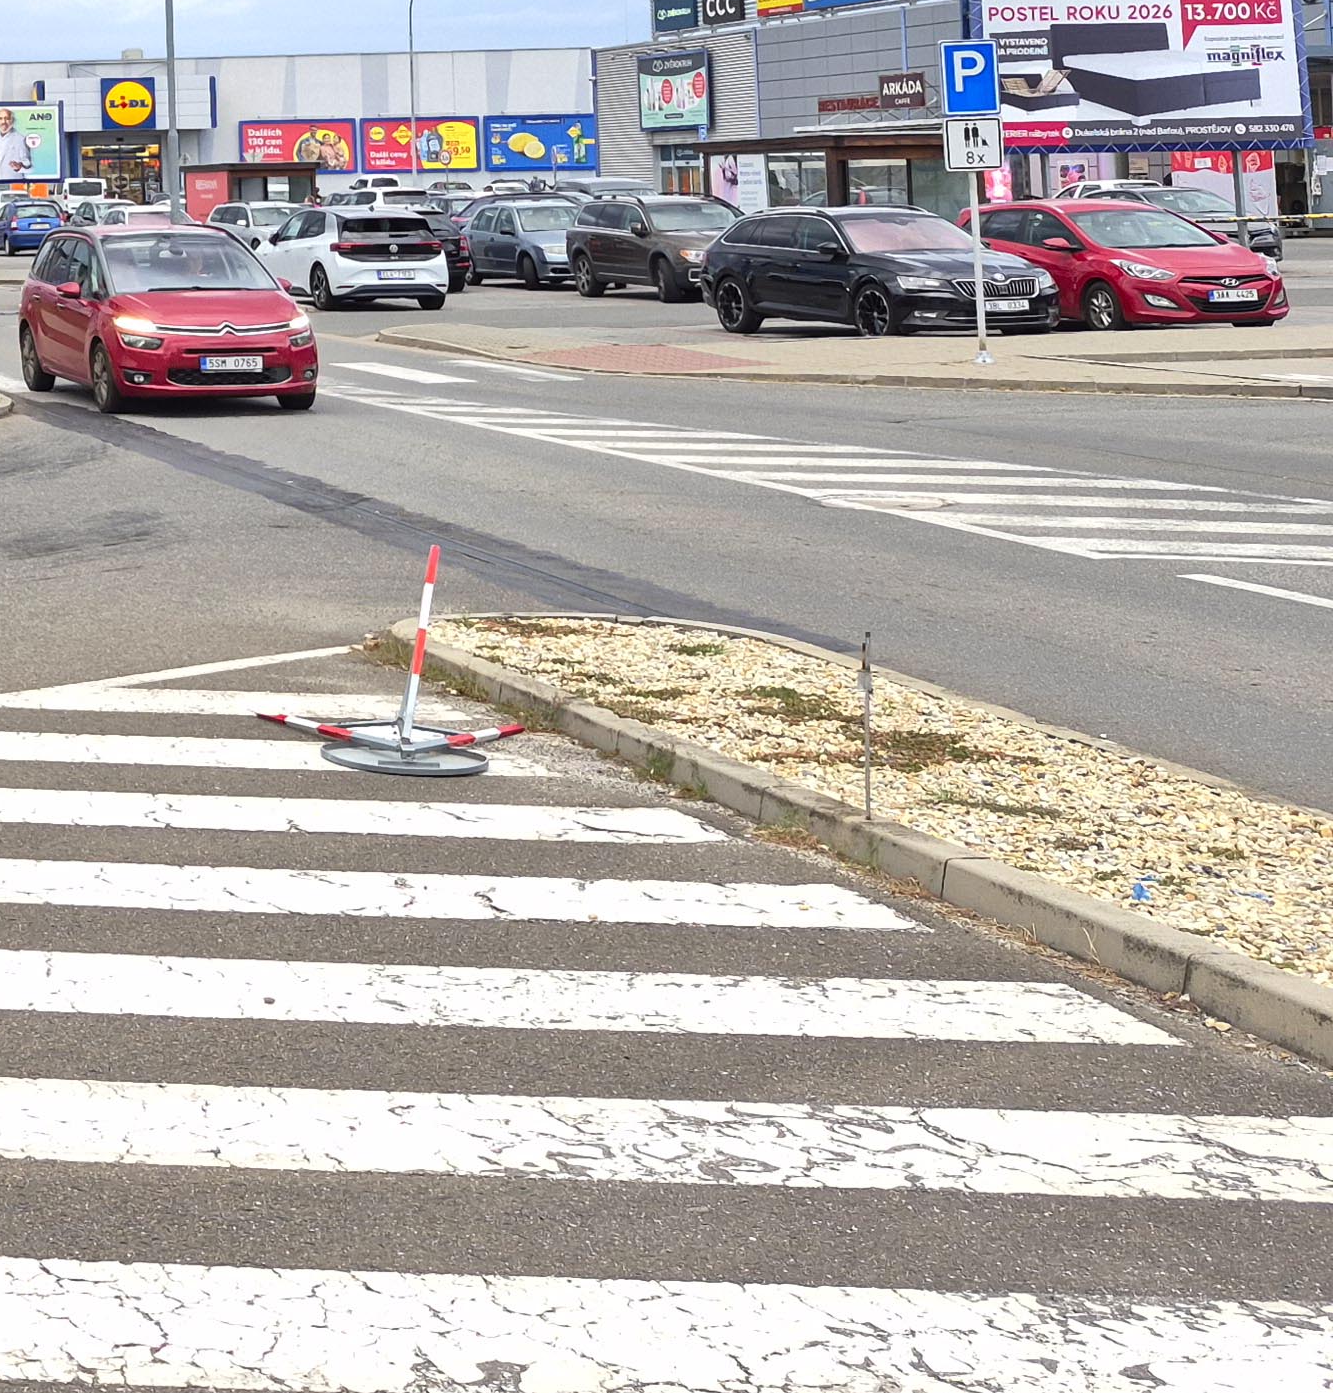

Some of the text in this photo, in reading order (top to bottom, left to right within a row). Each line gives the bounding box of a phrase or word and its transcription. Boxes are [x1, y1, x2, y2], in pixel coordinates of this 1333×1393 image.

[988, 4, 1173, 22] POSTEL ROKU 2026
[1184, 1, 1278, 20] 13.700 Kč
[999, 38, 1049, 46] VYSTAVENO
[1206, 45, 1286, 65] magniflex
[953, 50, 986, 93] P
[882, 78, 923, 96] ARKÁDA
[29, 112, 53, 121] ANO
[247, 127, 283, 137] Dalších
[1185, 124, 1232, 134] PROSTĚJOV
[248, 138, 264, 146] 130
[255, 146, 283, 154] klidu.
[209, 358, 258, 368] 5SM 0765
